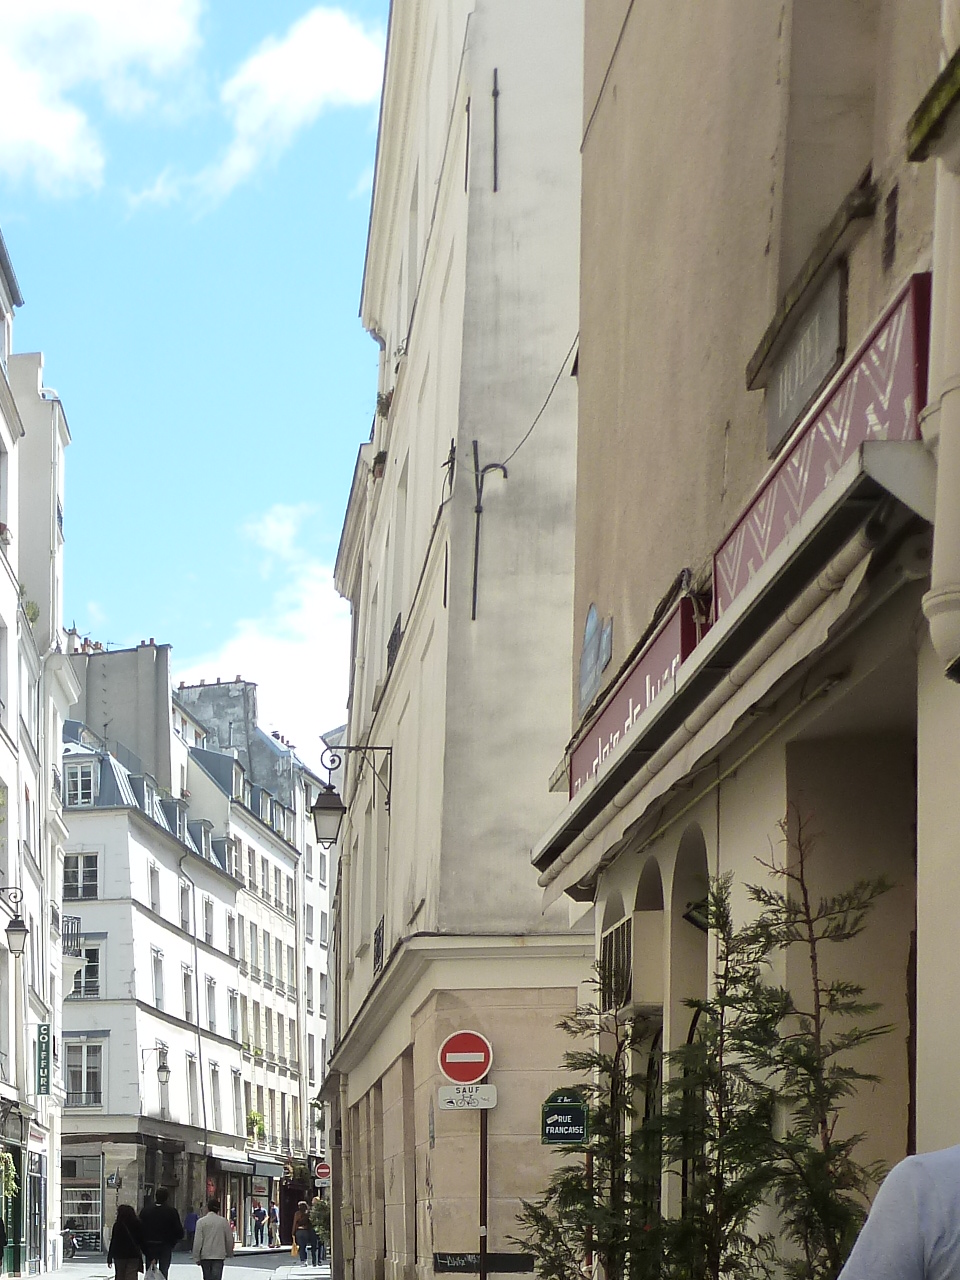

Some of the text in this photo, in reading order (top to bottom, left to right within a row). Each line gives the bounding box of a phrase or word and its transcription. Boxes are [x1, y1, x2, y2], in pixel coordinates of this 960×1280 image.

[39, 1026, 48, 1093] COIFFURE
[455, 1086, 480, 1094] SAUF
[558, 1115, 572, 1123] RUE
[545, 1126, 584, 1135] FRANÇAISE
